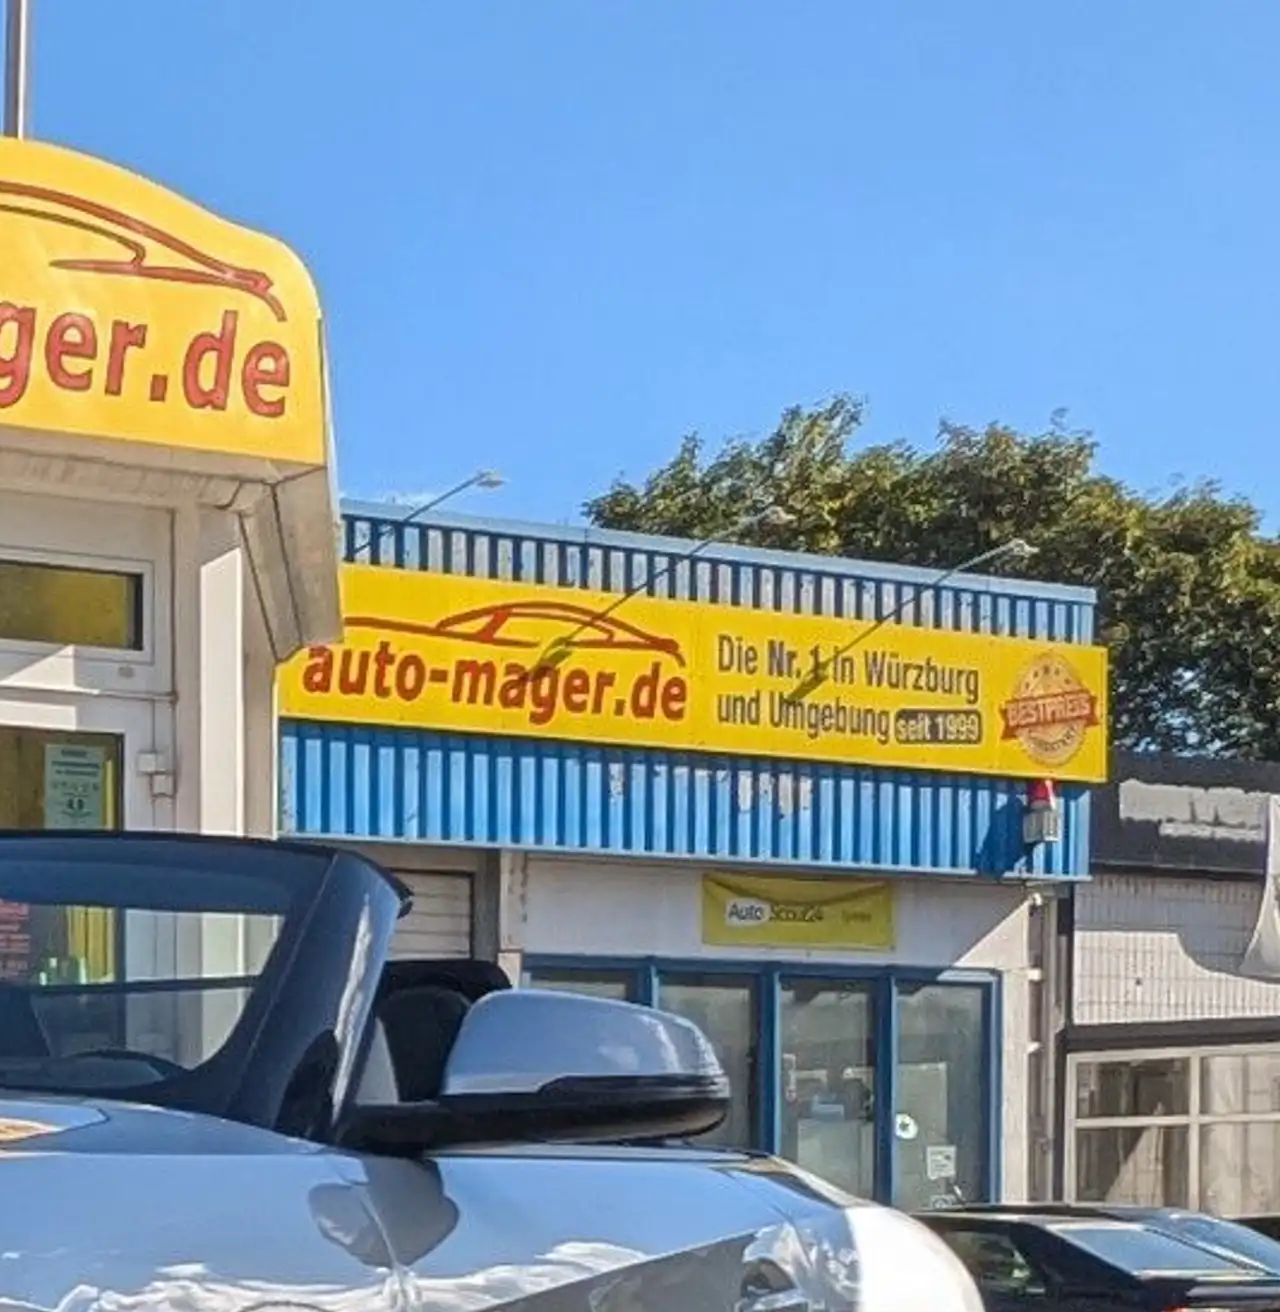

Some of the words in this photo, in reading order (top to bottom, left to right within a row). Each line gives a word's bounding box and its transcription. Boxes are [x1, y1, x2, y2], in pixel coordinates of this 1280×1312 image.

[302, 641, 688, 725] auto-mager.de
[718, 634, 757, 675] Die
[768, 639, 802, 679] Nr.
[833, 646, 855, 685] in
[865, 650, 980, 705] Würzburg
[718, 691, 762, 726] und
[770, 691, 890, 745] Umgebung
[896, 713, 933, 741] seit
[936, 713, 980, 742] 1999
